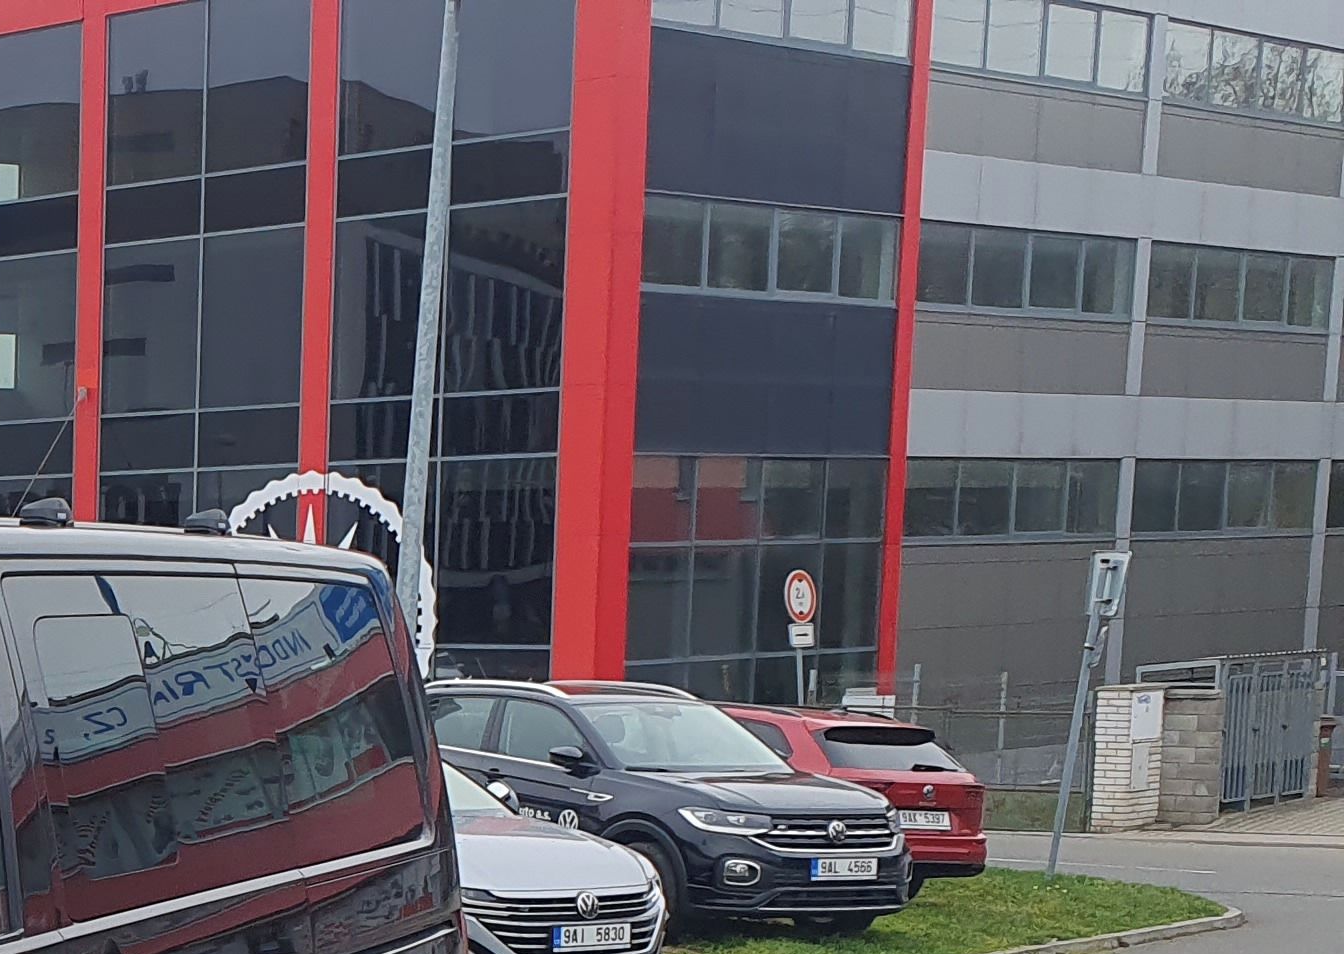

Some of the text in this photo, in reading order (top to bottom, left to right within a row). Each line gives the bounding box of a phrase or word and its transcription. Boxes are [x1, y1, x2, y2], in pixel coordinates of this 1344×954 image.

[924, 813, 945, 825] 5397
[820, 860, 873, 874] 9AL 4566
[563, 926, 625, 944] 9AI 5830
